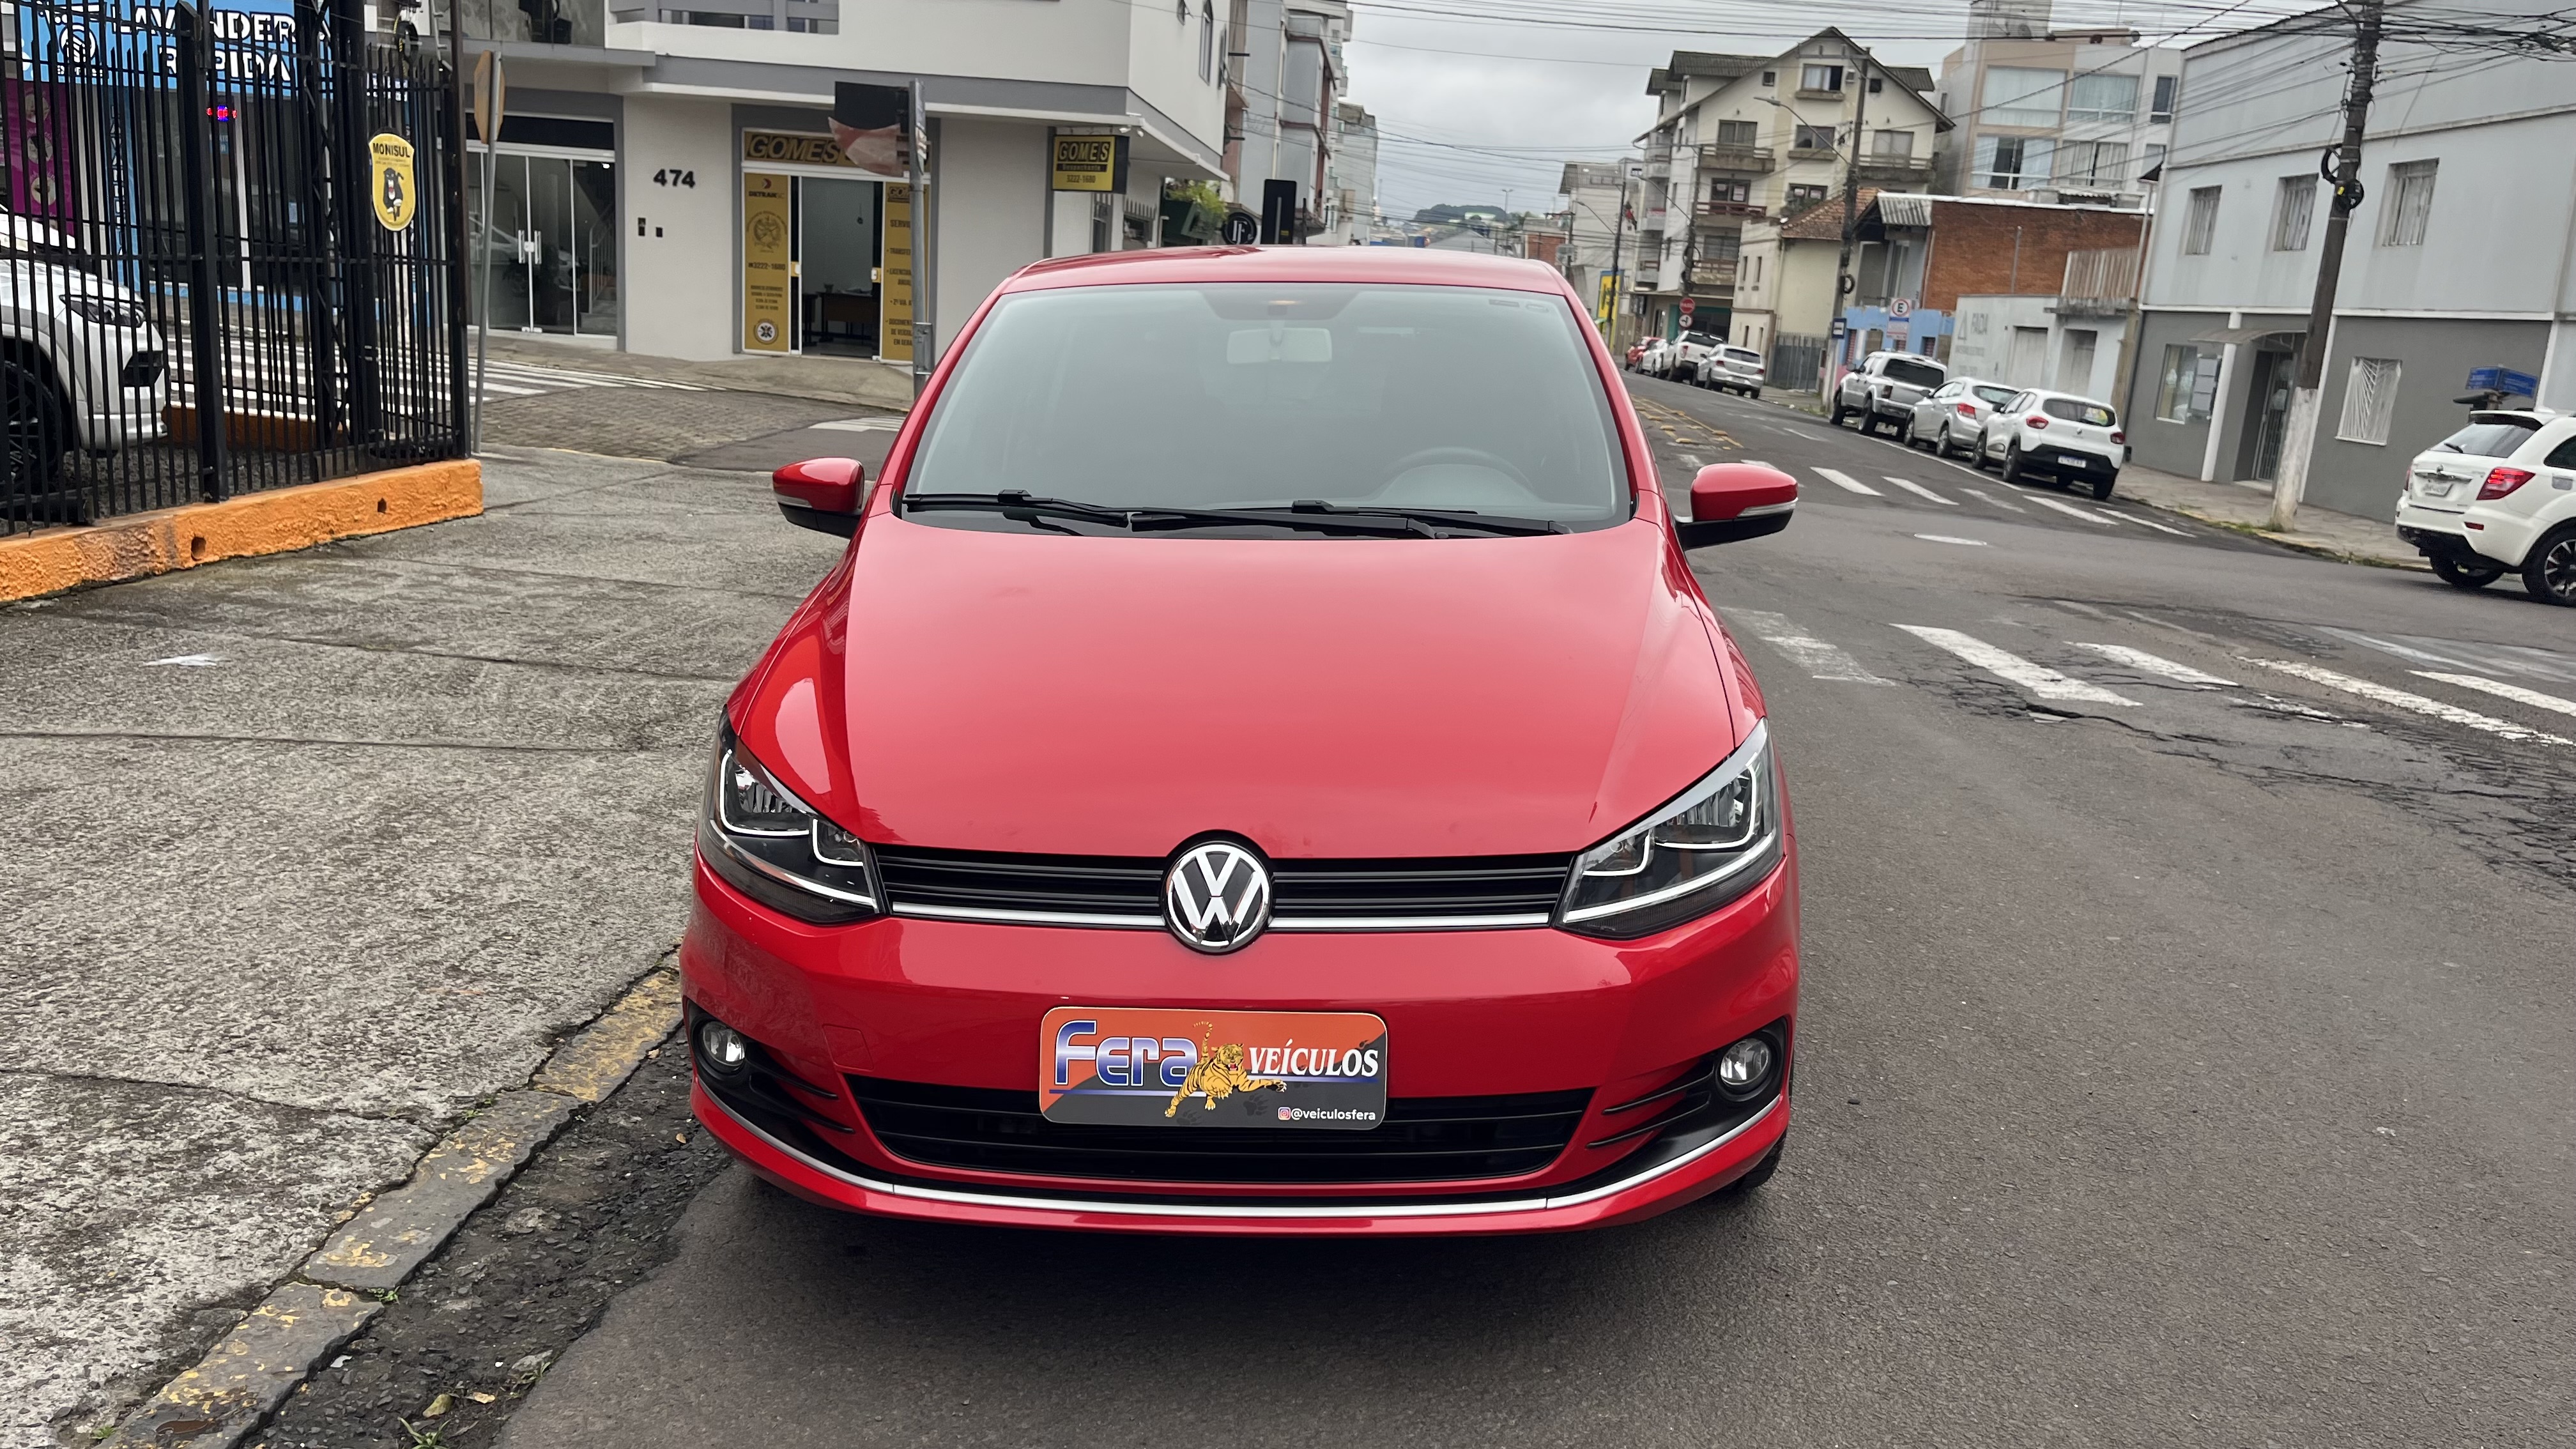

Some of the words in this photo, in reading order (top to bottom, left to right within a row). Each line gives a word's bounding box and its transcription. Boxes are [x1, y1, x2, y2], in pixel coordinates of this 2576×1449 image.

[372, 142, 410, 157] MONISUL
[748, 135, 840, 164] GOMES
[1059, 142, 1110, 160] GOMES
[653, 169, 696, 188] 474
[1897, 303, 1904, 312] E
[1055, 1020, 1199, 1087] Fera
[1249, 1039, 1379, 1077] VEÍCULOS
[1291, 1108, 1376, 1121] @veiculosfera
